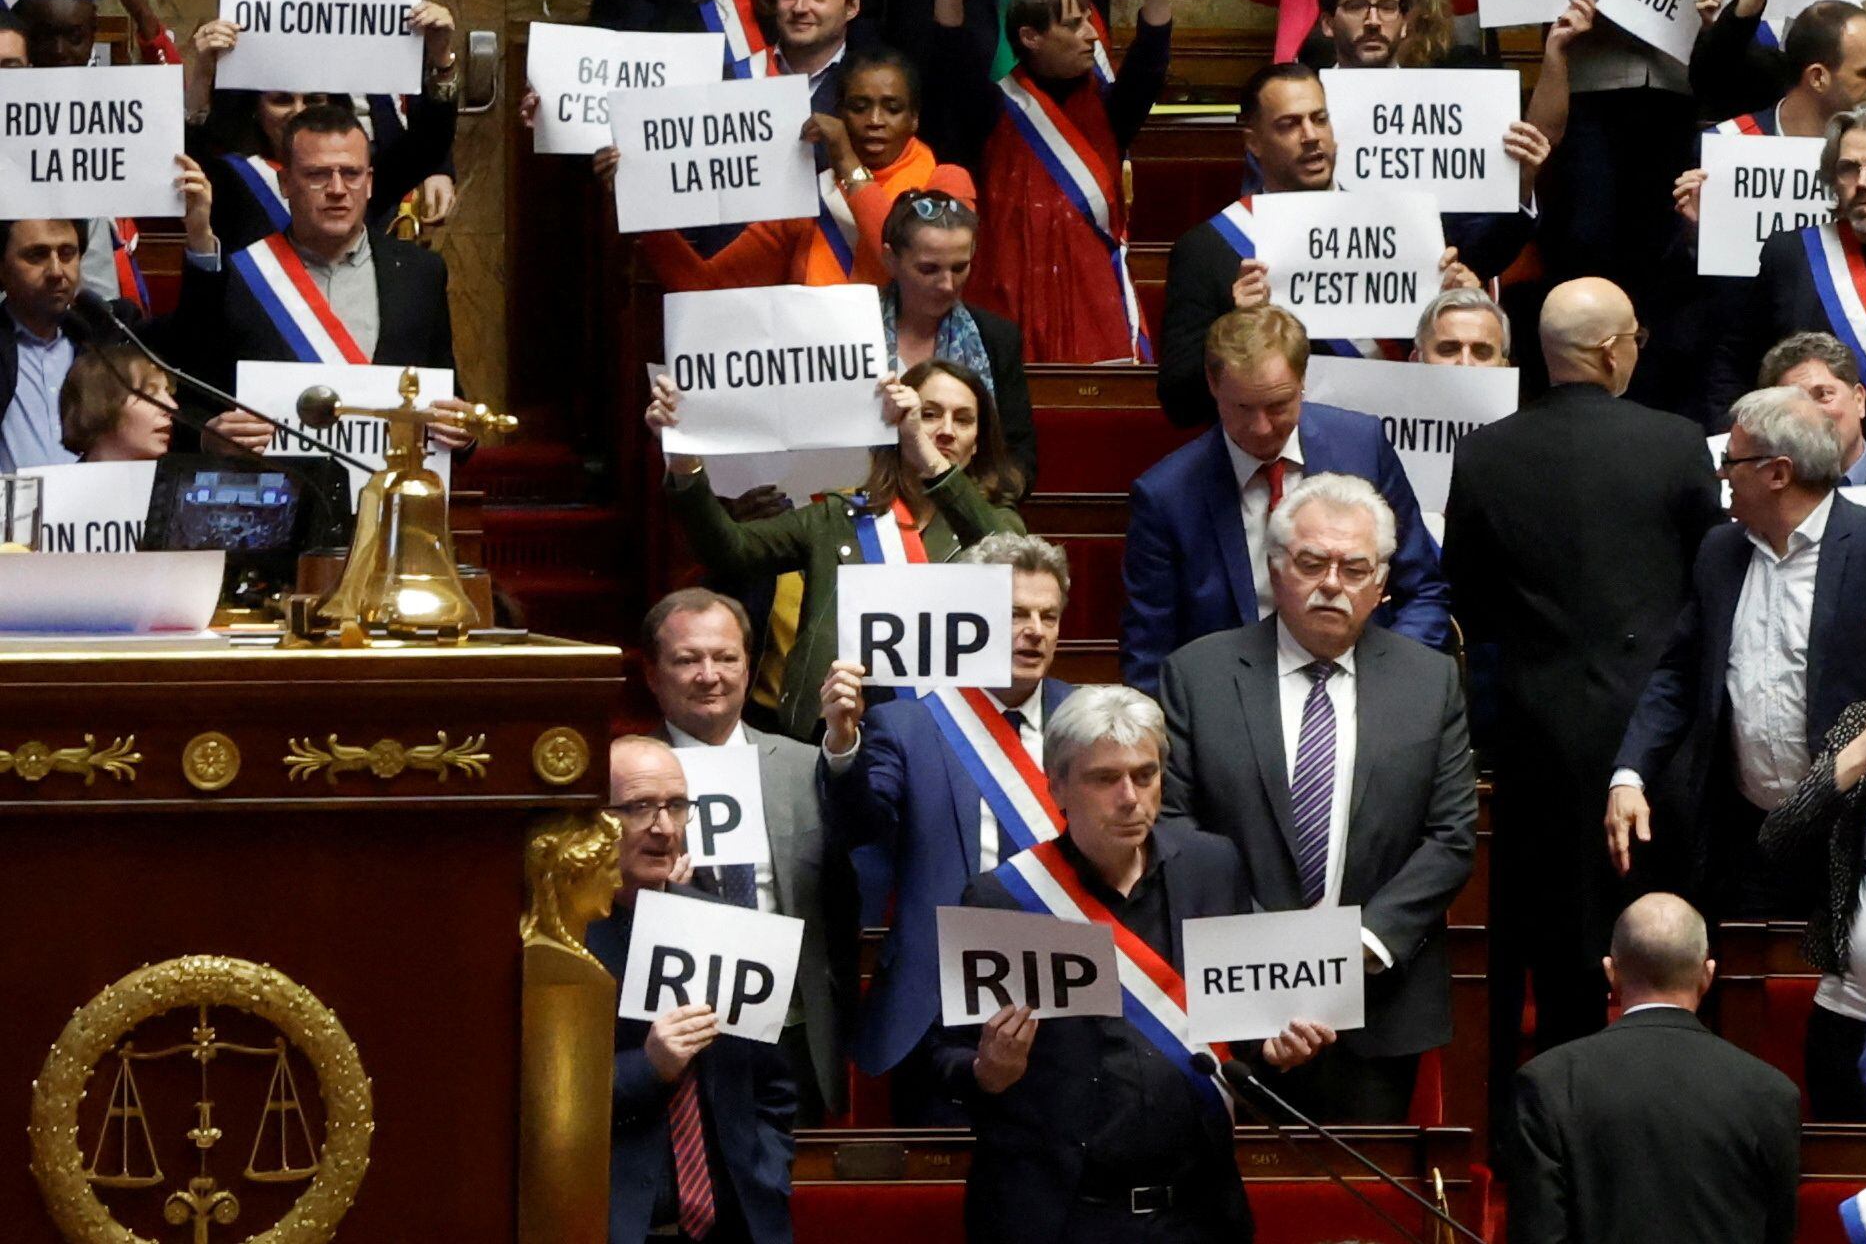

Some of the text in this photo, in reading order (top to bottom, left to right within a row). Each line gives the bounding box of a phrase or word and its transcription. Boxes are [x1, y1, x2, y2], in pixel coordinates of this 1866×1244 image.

[235, 0, 412, 38] ON CONTINUE
[577, 56, 666, 89] 64 ANS
[5, 99, 144, 137] RDV DANS
[642, 109, 774, 152] RDV DANS
[1372, 103, 1463, 136] 64 ANS
[30, 147, 126, 183] LA RUE
[670, 154, 761, 194] LA RUE
[1355, 145, 1486, 180] C'EST NON
[1734, 166, 1786, 200] RDV
[1308, 225, 1397, 261] 64 ANS
[1289, 270, 1418, 306] C'EST NON
[674, 343, 879, 392] ON CONTINUE
[860, 611, 991, 682] RIP
[643, 944, 775, 1028] RIP
[961, 949, 1099, 1016] RIP
[1203, 956, 1348, 995] RETRAIT
